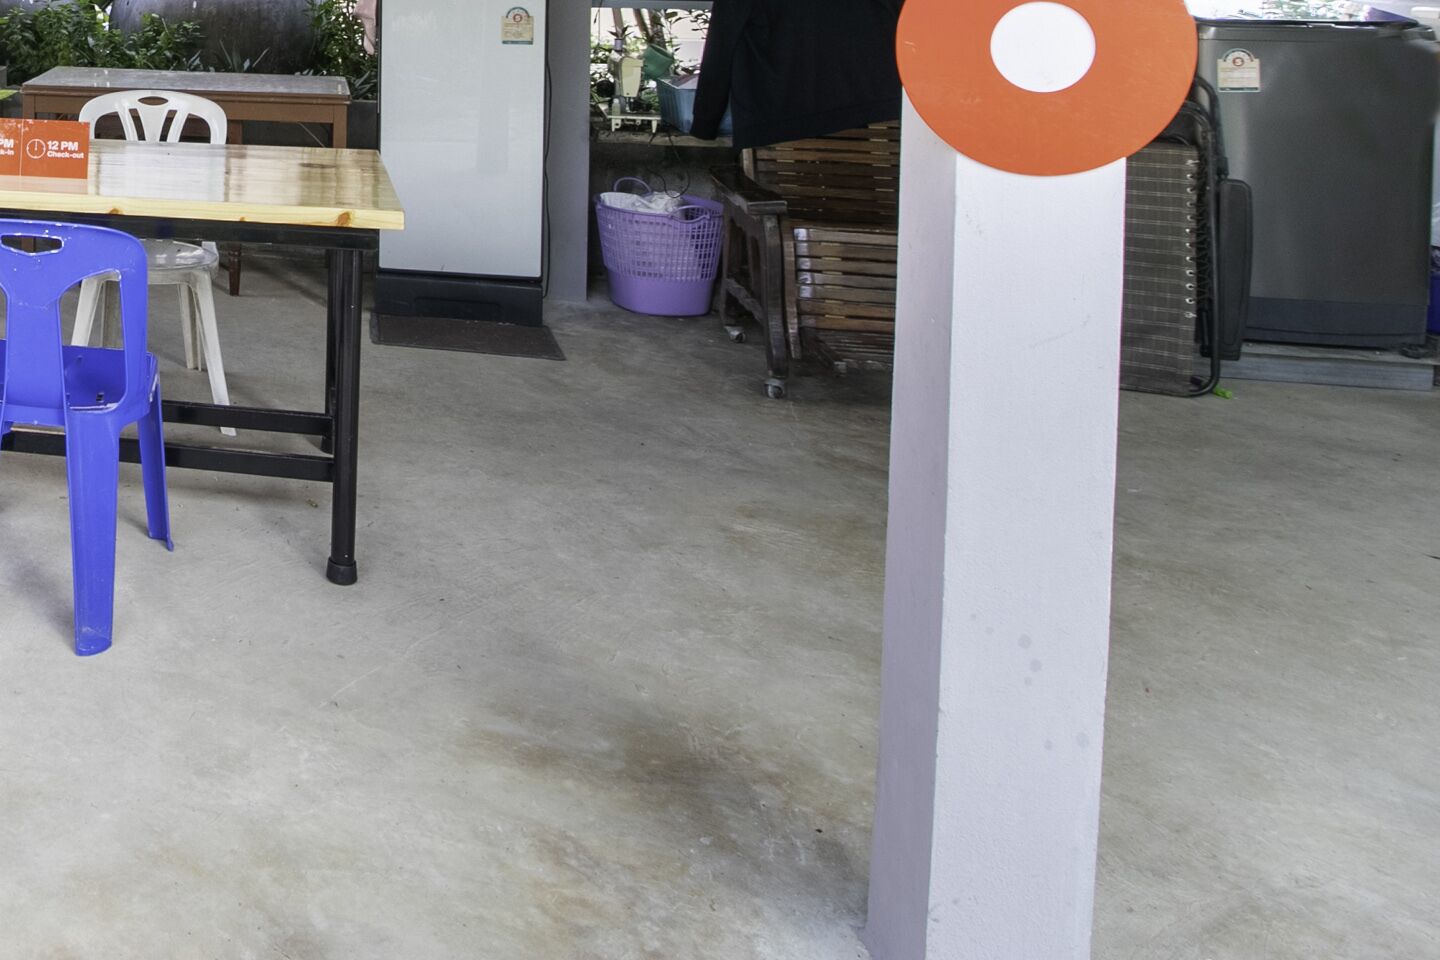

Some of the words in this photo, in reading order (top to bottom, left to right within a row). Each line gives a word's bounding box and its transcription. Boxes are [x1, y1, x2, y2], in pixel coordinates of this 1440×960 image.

[47, 140, 59, 151] 12
[60, 141, 79, 151] PM
[47, 151, 84, 159] Check-out
